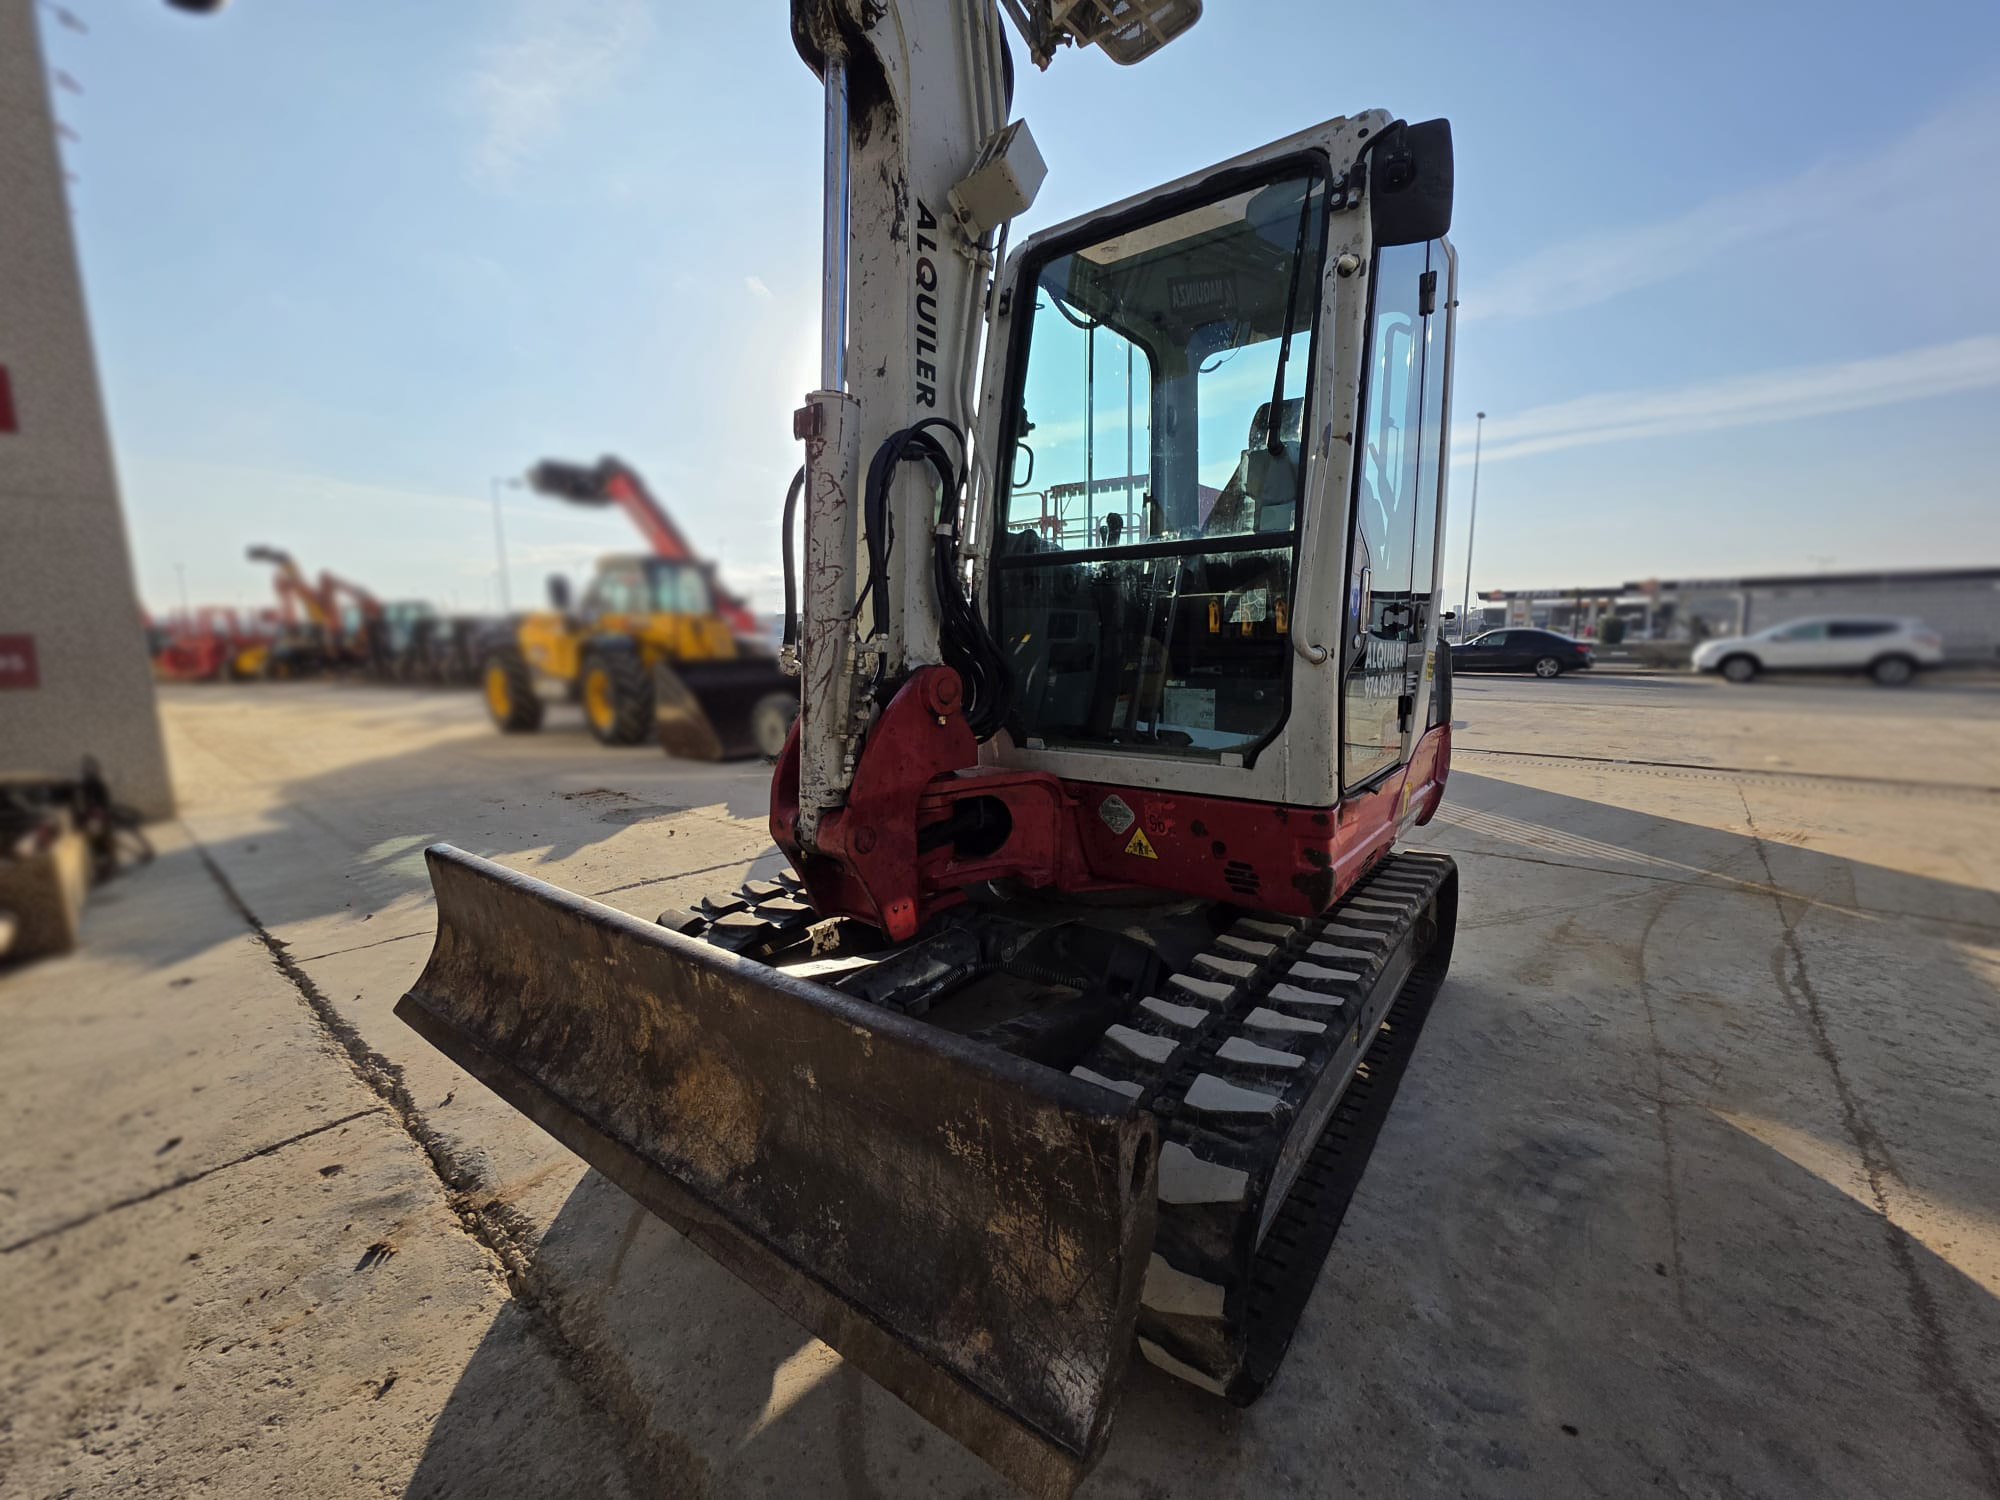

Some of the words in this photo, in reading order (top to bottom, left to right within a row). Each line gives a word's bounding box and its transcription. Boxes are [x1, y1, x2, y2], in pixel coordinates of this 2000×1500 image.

[916, 198, 937, 408] ALQUILER
[1364, 642, 1404, 671] ALQUILER
[1364, 675, 1378, 699] 974
